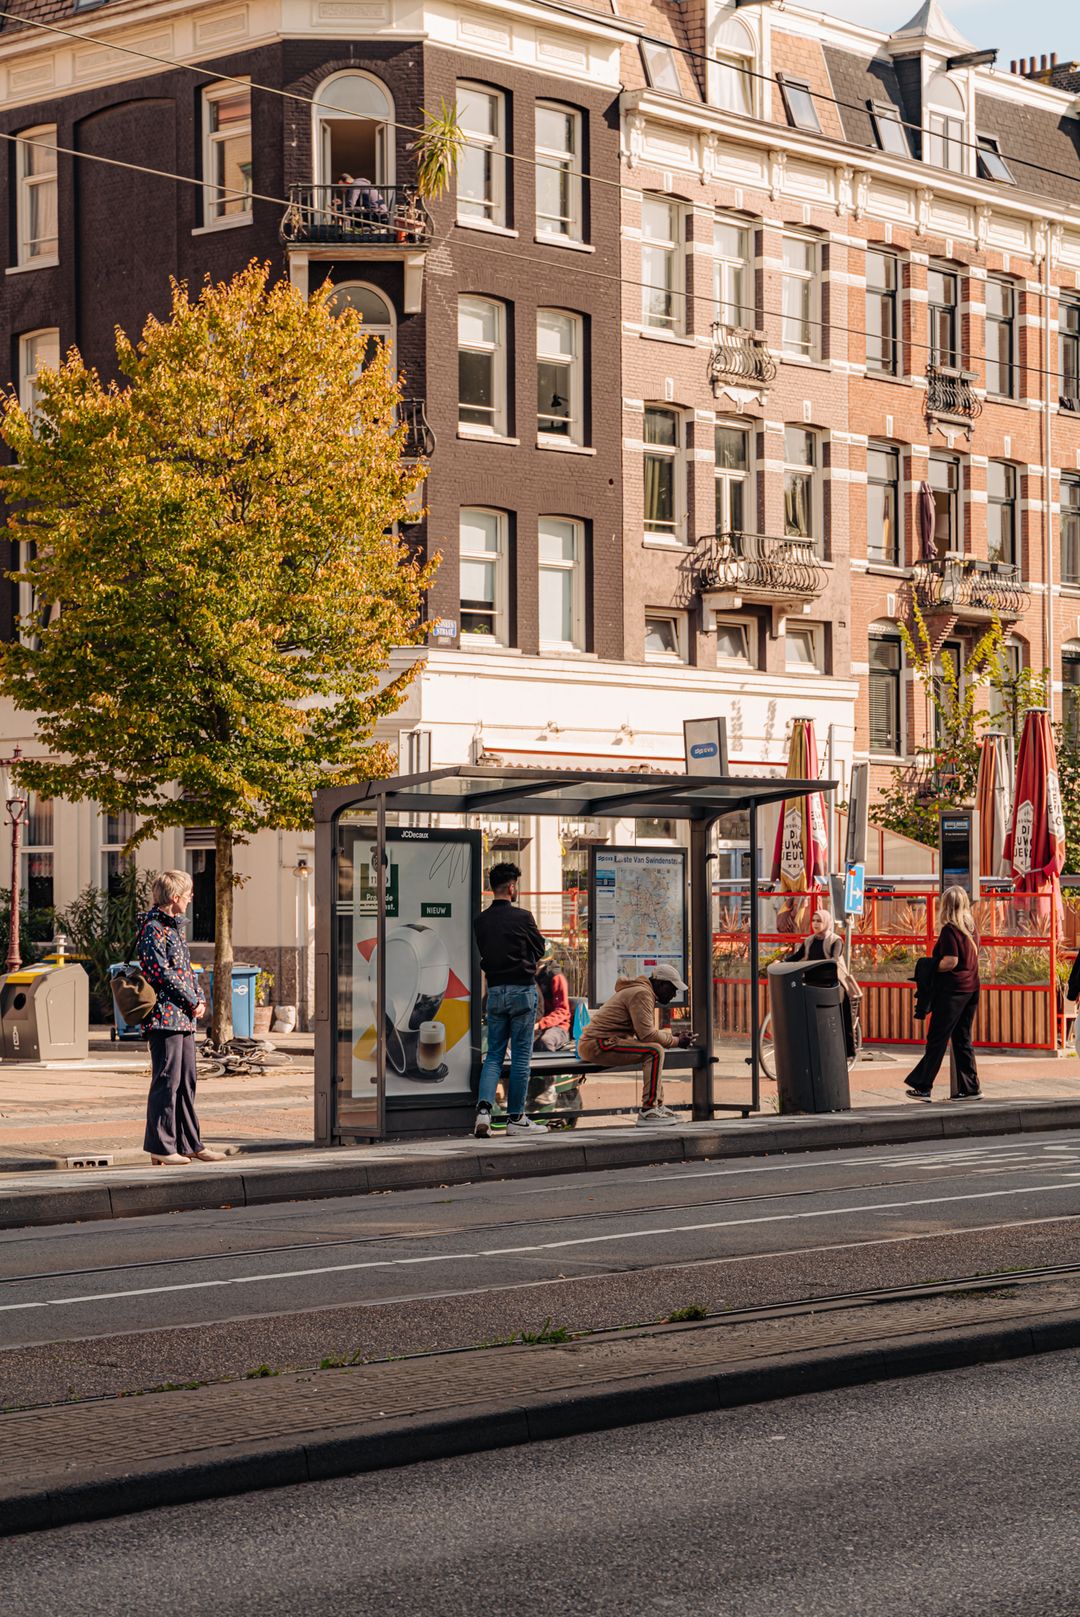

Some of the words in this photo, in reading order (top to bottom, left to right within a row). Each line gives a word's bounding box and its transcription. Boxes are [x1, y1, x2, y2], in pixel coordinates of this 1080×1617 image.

[401, 830, 429, 839] JCDecaux
[633, 856, 644, 864] Van
[426, 906, 447, 915] NIEUW
